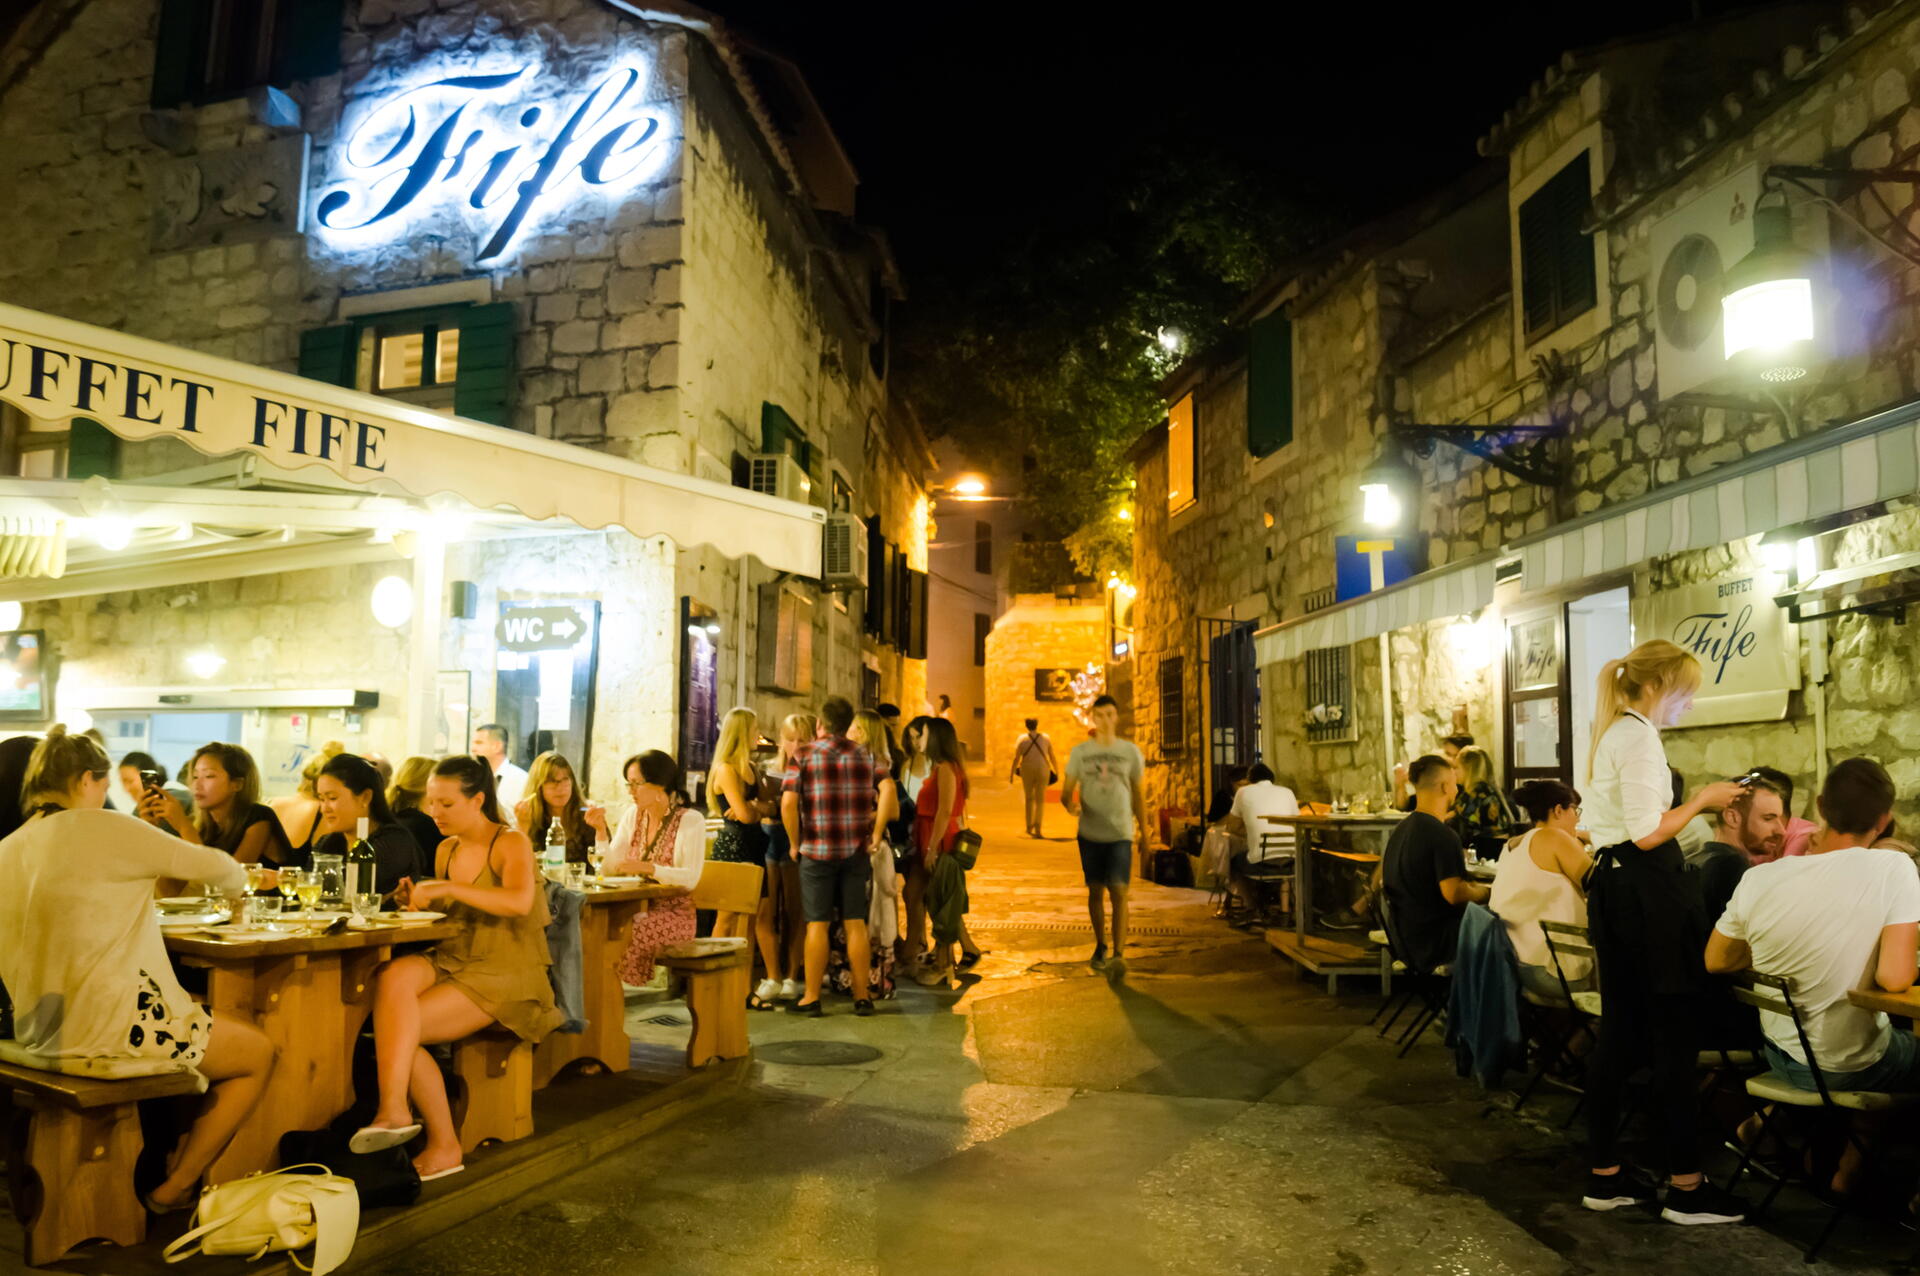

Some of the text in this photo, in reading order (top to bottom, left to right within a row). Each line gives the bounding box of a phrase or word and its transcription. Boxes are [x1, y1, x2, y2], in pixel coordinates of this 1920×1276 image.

[317, 64, 659, 262] Fife
[248, 395, 387, 473] FIFE
[1718, 577, 1754, 598] BUFFET
[504, 617, 544, 643] WC
[1672, 603, 1757, 685] Fife
